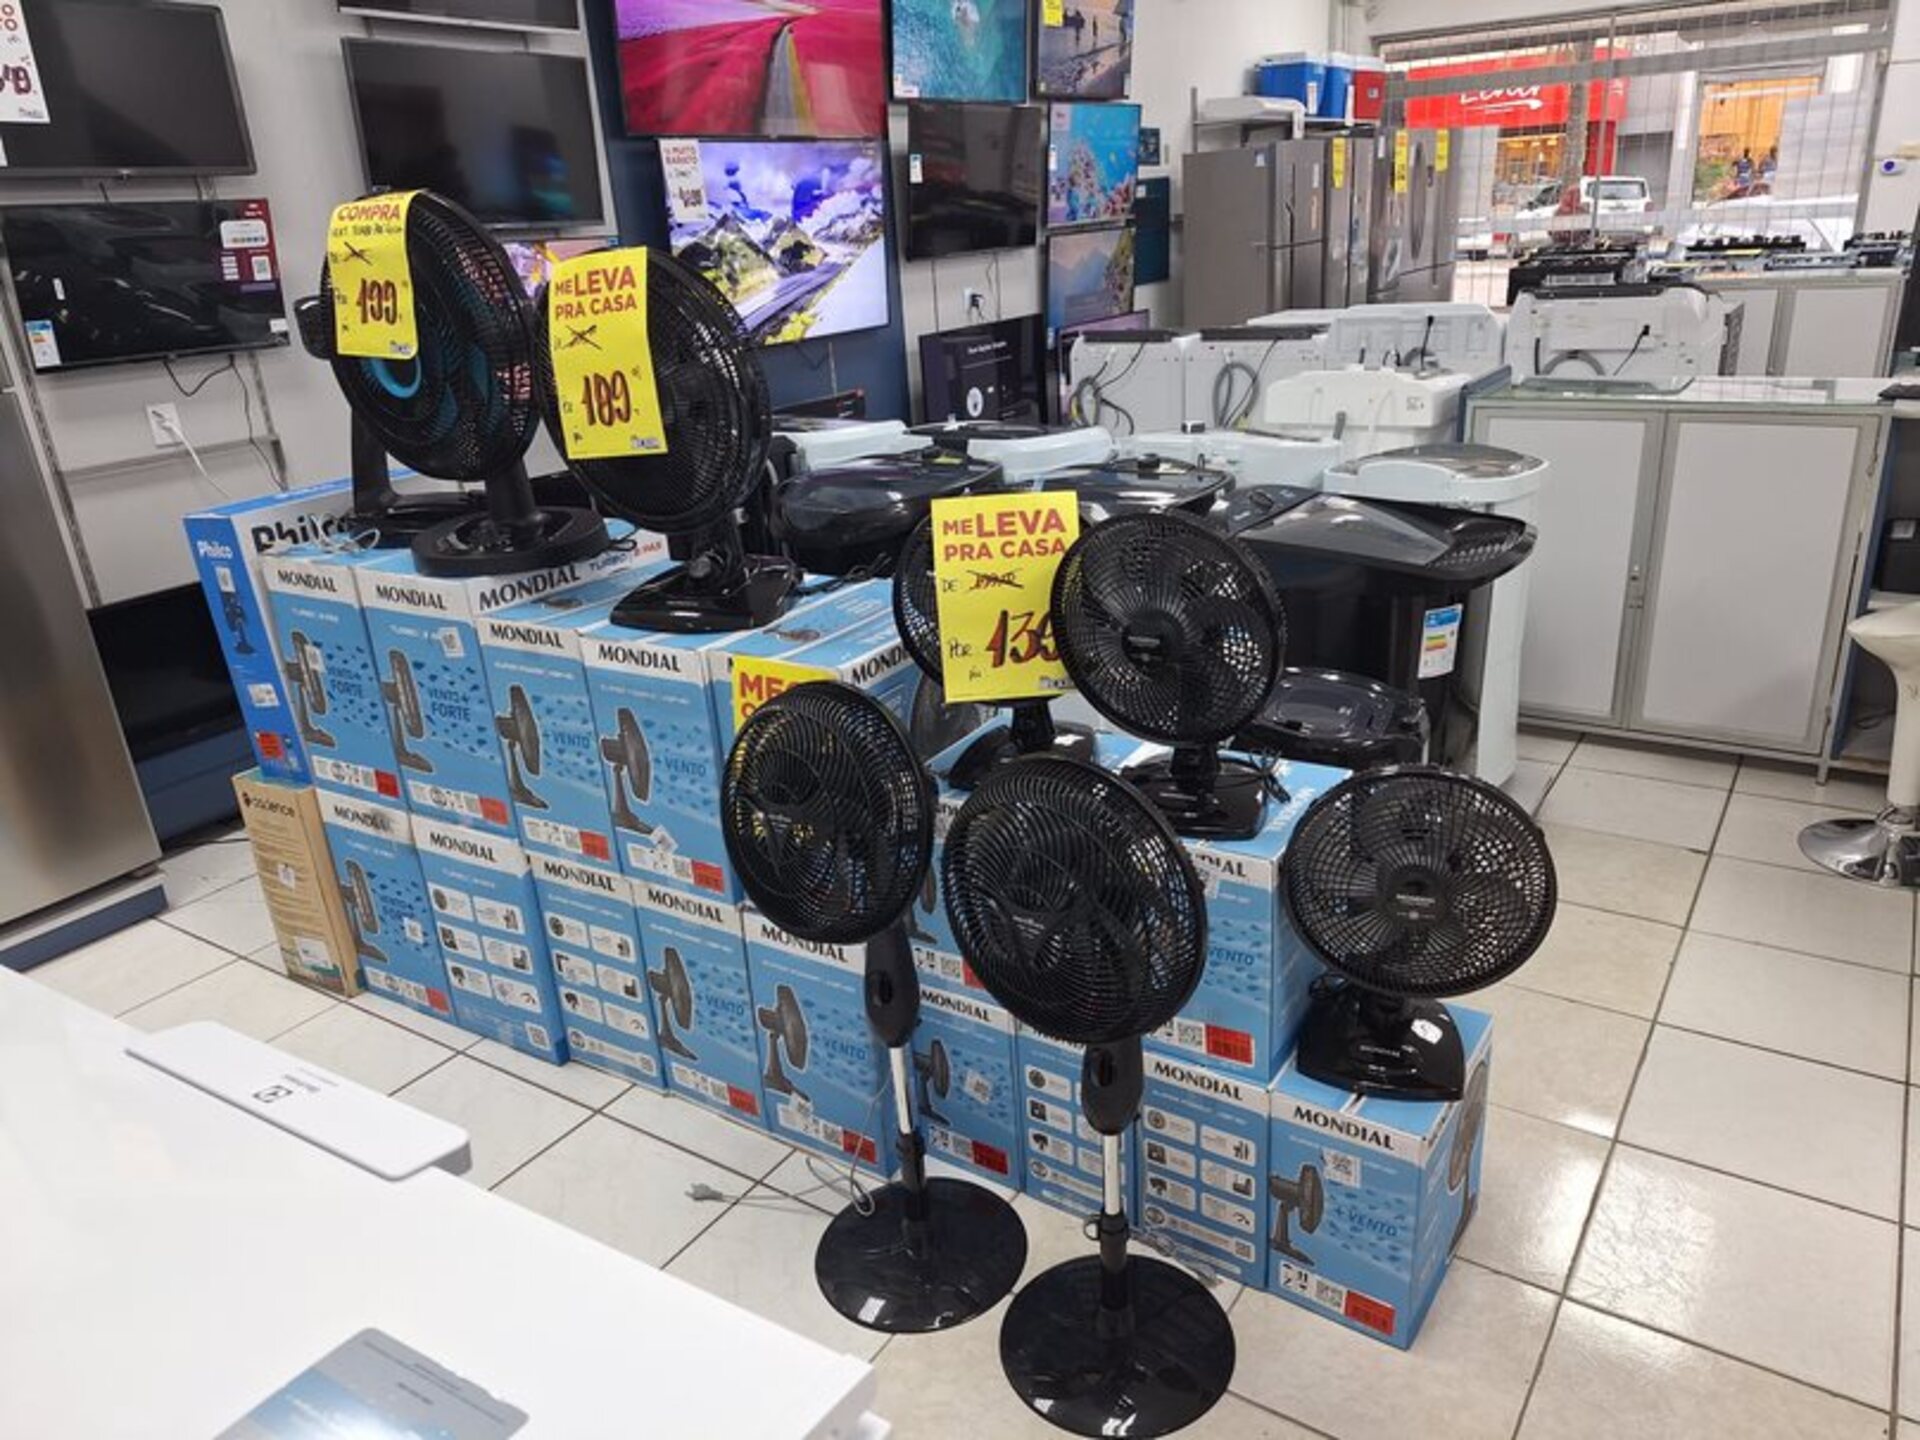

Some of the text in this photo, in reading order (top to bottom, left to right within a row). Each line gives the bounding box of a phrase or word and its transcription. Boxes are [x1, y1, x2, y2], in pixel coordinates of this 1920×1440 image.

[337, 203, 400, 221] COMPRA
[574, 264, 636, 298] LEVA
[356, 277, 398, 326] 199
[555, 294, 638, 321] PRA CASA
[581, 369, 631, 427] 189
[942, 508, 1067, 538] ME LEVA
[196, 540, 234, 559] Philco
[943, 537, 1066, 562] PRA CASA
[277, 568, 338, 593] MONDIAL
[479, 562, 582, 611] MONDIAL
[375, 584, 448, 611] MONDIAL
[489, 622, 564, 649] MONDIAL
[598, 644, 682, 673] MONDIAL
[852, 645, 907, 685] MOND
[551, 731, 591, 749] VENTO
[664, 757, 707, 777] VENTO
[333, 804, 392, 831] MONDIAL
[430, 831, 498, 863] MONDIAL
[543, 861, 616, 892] MONDIAL
[647, 887, 724, 923] MONDIAL
[760, 923, 849, 963] MONDIAL
[704, 994, 745, 1017] VENTO
[919, 989, 992, 1022] MONDIAL
[823, 1039, 867, 1061] VENTO
[1153, 1060, 1244, 1101] MONDIAL
[1293, 1104, 1396, 1151] MONDIAL
[1348, 1208, 1399, 1238] VENTO
